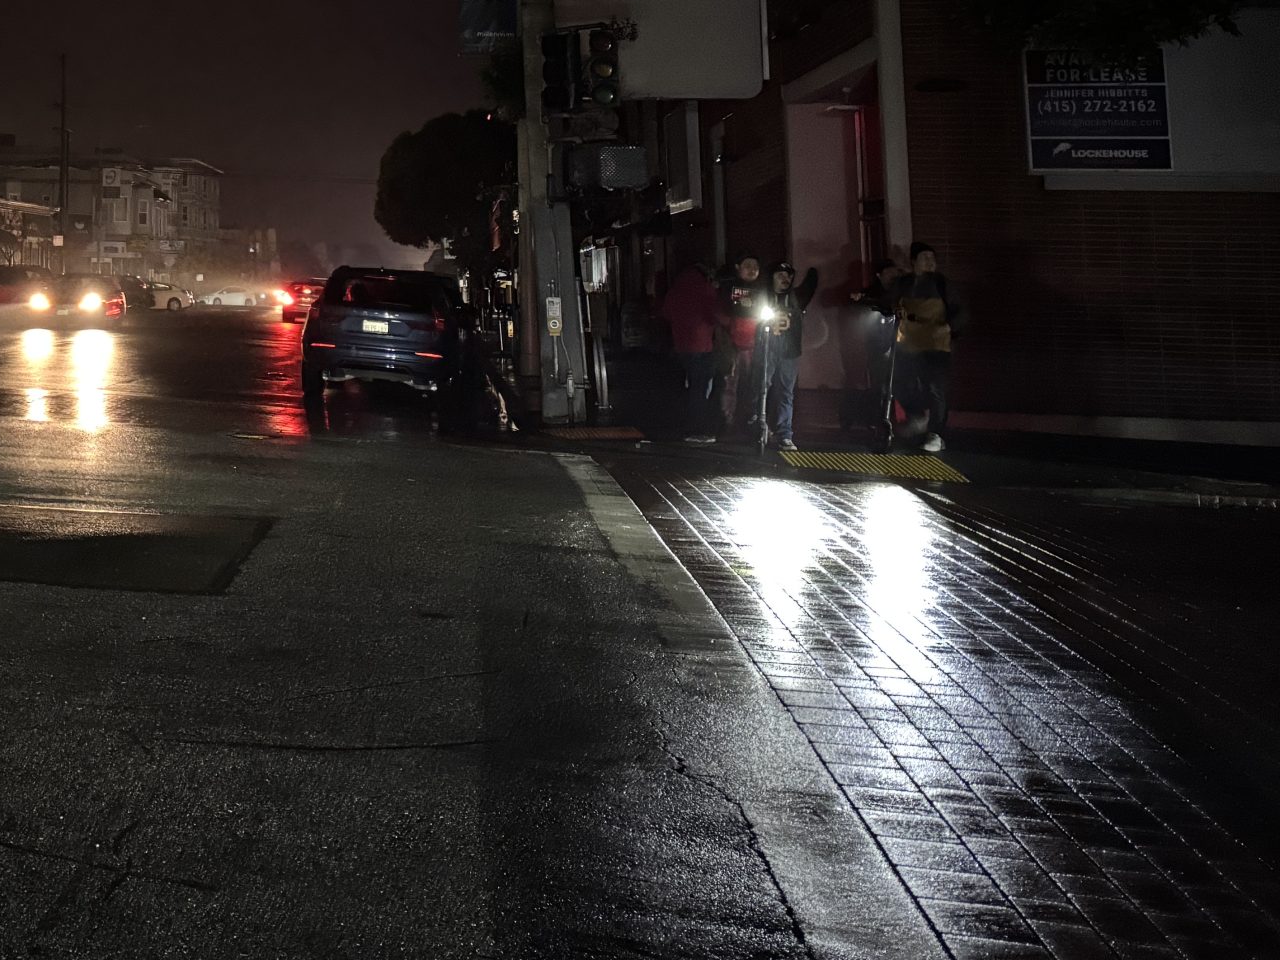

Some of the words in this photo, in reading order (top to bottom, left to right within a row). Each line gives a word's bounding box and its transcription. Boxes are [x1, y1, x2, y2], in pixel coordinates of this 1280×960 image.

[1045, 69, 1081, 82] FOR
[1088, 65, 1148, 81] LEASE
[1037, 100, 1077, 116] (415)
[1083, 100, 1158, 113] 272-2162
[1071, 149, 1150, 159] LOCKEHOUSE
